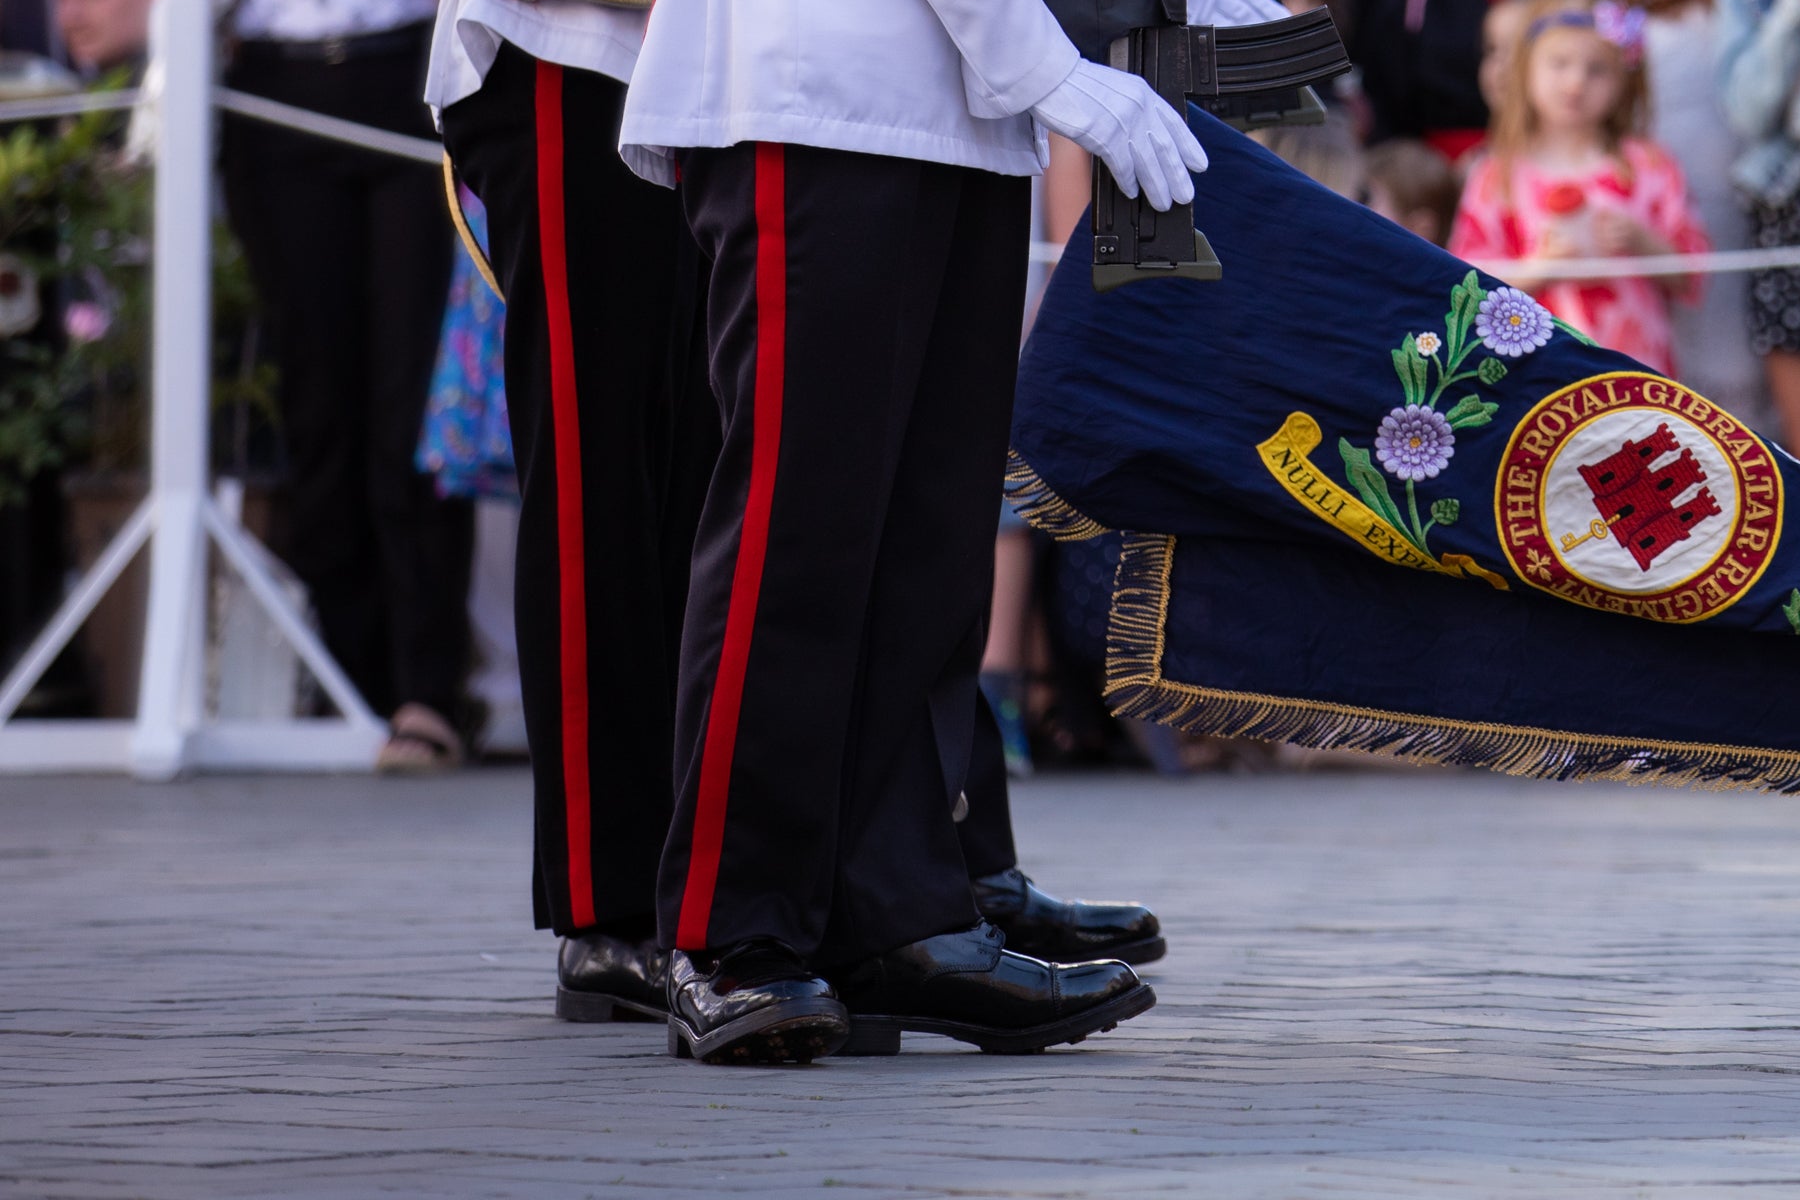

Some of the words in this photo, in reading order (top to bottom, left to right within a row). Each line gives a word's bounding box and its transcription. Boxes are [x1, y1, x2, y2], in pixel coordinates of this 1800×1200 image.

[1519, 379, 1631, 460] ROYAL
[1272, 448, 1348, 519] NULLI
[1506, 465, 1539, 546] THE
[1642, 380, 1774, 552] GIBRALTAR
[1552, 557, 1752, 620] REGIMENT
